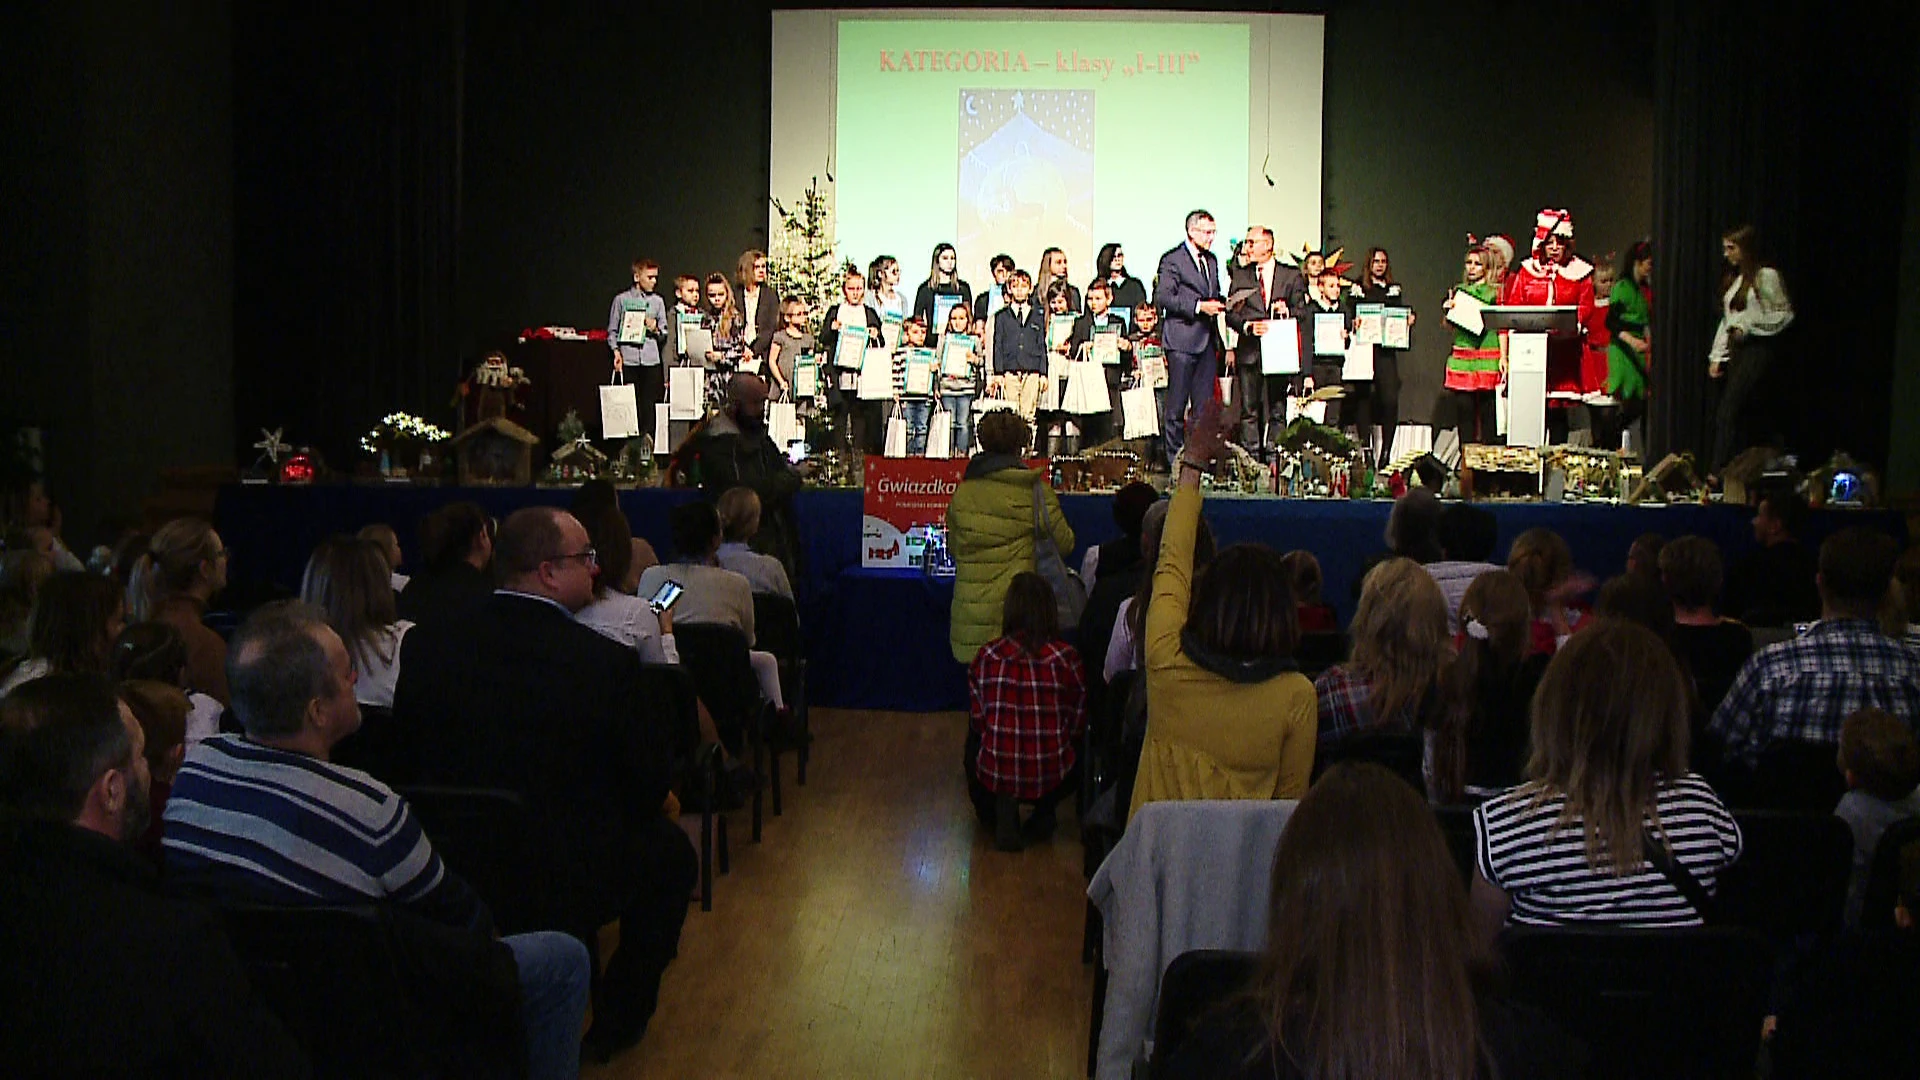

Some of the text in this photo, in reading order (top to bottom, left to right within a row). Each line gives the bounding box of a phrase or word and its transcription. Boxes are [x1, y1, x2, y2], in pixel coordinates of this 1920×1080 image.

[880, 49, 1030, 72] KATEGORIA
[1056, 48, 1115, 81] klasy
[877, 477, 957, 495] Gwiazdka
